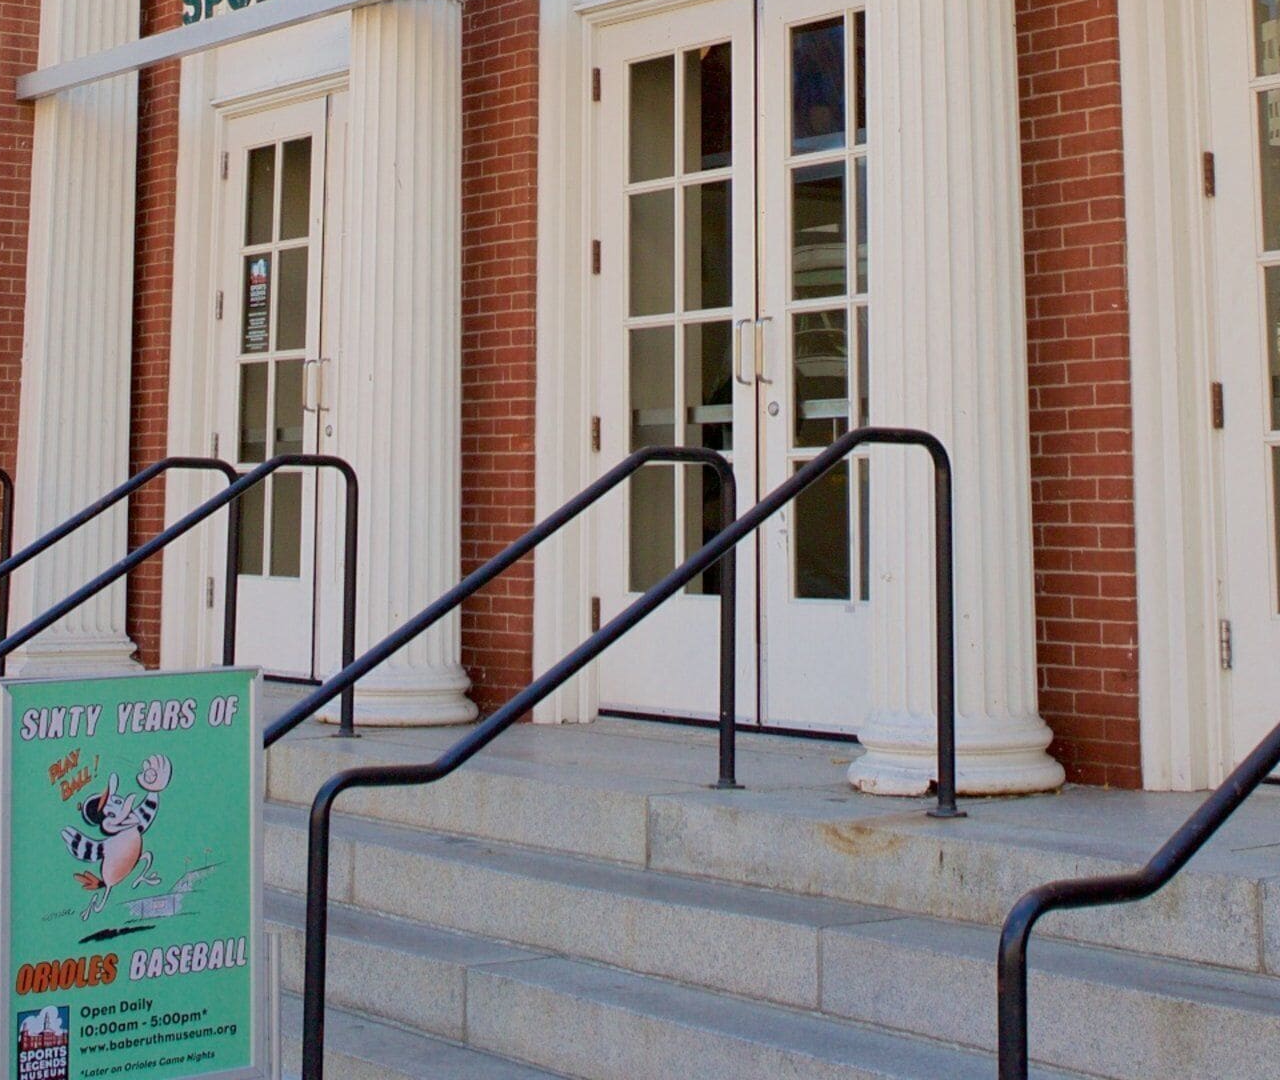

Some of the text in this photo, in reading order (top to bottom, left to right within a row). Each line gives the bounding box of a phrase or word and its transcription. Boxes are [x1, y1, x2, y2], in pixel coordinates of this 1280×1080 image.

[20, 695, 239, 741] SIXTY YEARS OF
[48, 748, 81, 785] PLAY
[128, 936, 248, 982] BASEBALL
[80, 998, 153, 1019] Open Daily
[80, 1020, 138, 1038] 10:00am
[80, 1023, 237, 1055] www.baberuthmuseum.org
[20, 1046, 67, 1062] SPORTS
[21, 1057, 67, 1073] LEGENDS
[111, 1065, 122, 1073] on
[124, 1059, 157, 1071] Orioles
[159, 1055, 184, 1067] Game
[187, 1050, 215, 1063] Nights
[21, 1068, 66, 1080] MUSEUM
